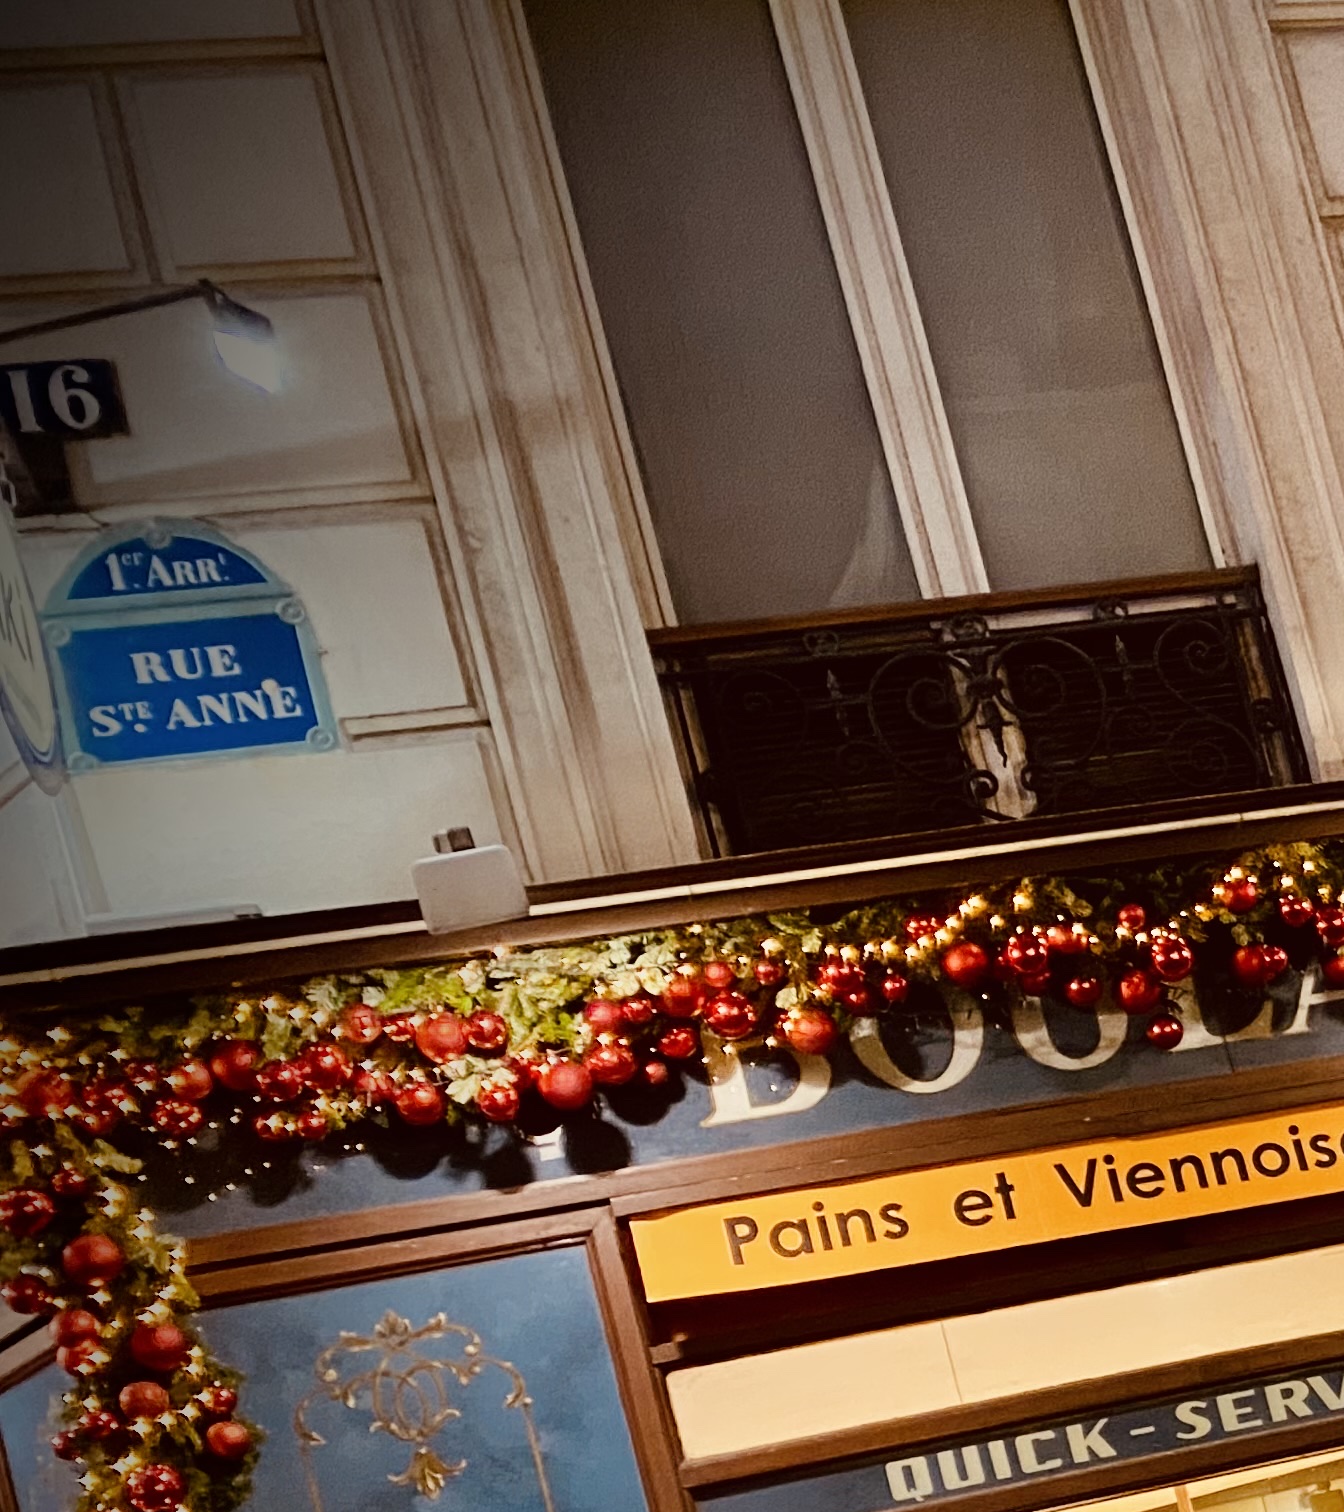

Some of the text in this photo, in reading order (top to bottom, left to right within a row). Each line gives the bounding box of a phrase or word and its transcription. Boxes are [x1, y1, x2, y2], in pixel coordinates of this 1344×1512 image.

[7, 364, 101, 433] 16
[129, 644, 242, 685] RUE
[167, 686, 303, 730] ANNE
[728, 1201, 911, 1268] Pains
[953, 1169, 1020, 1230] et
